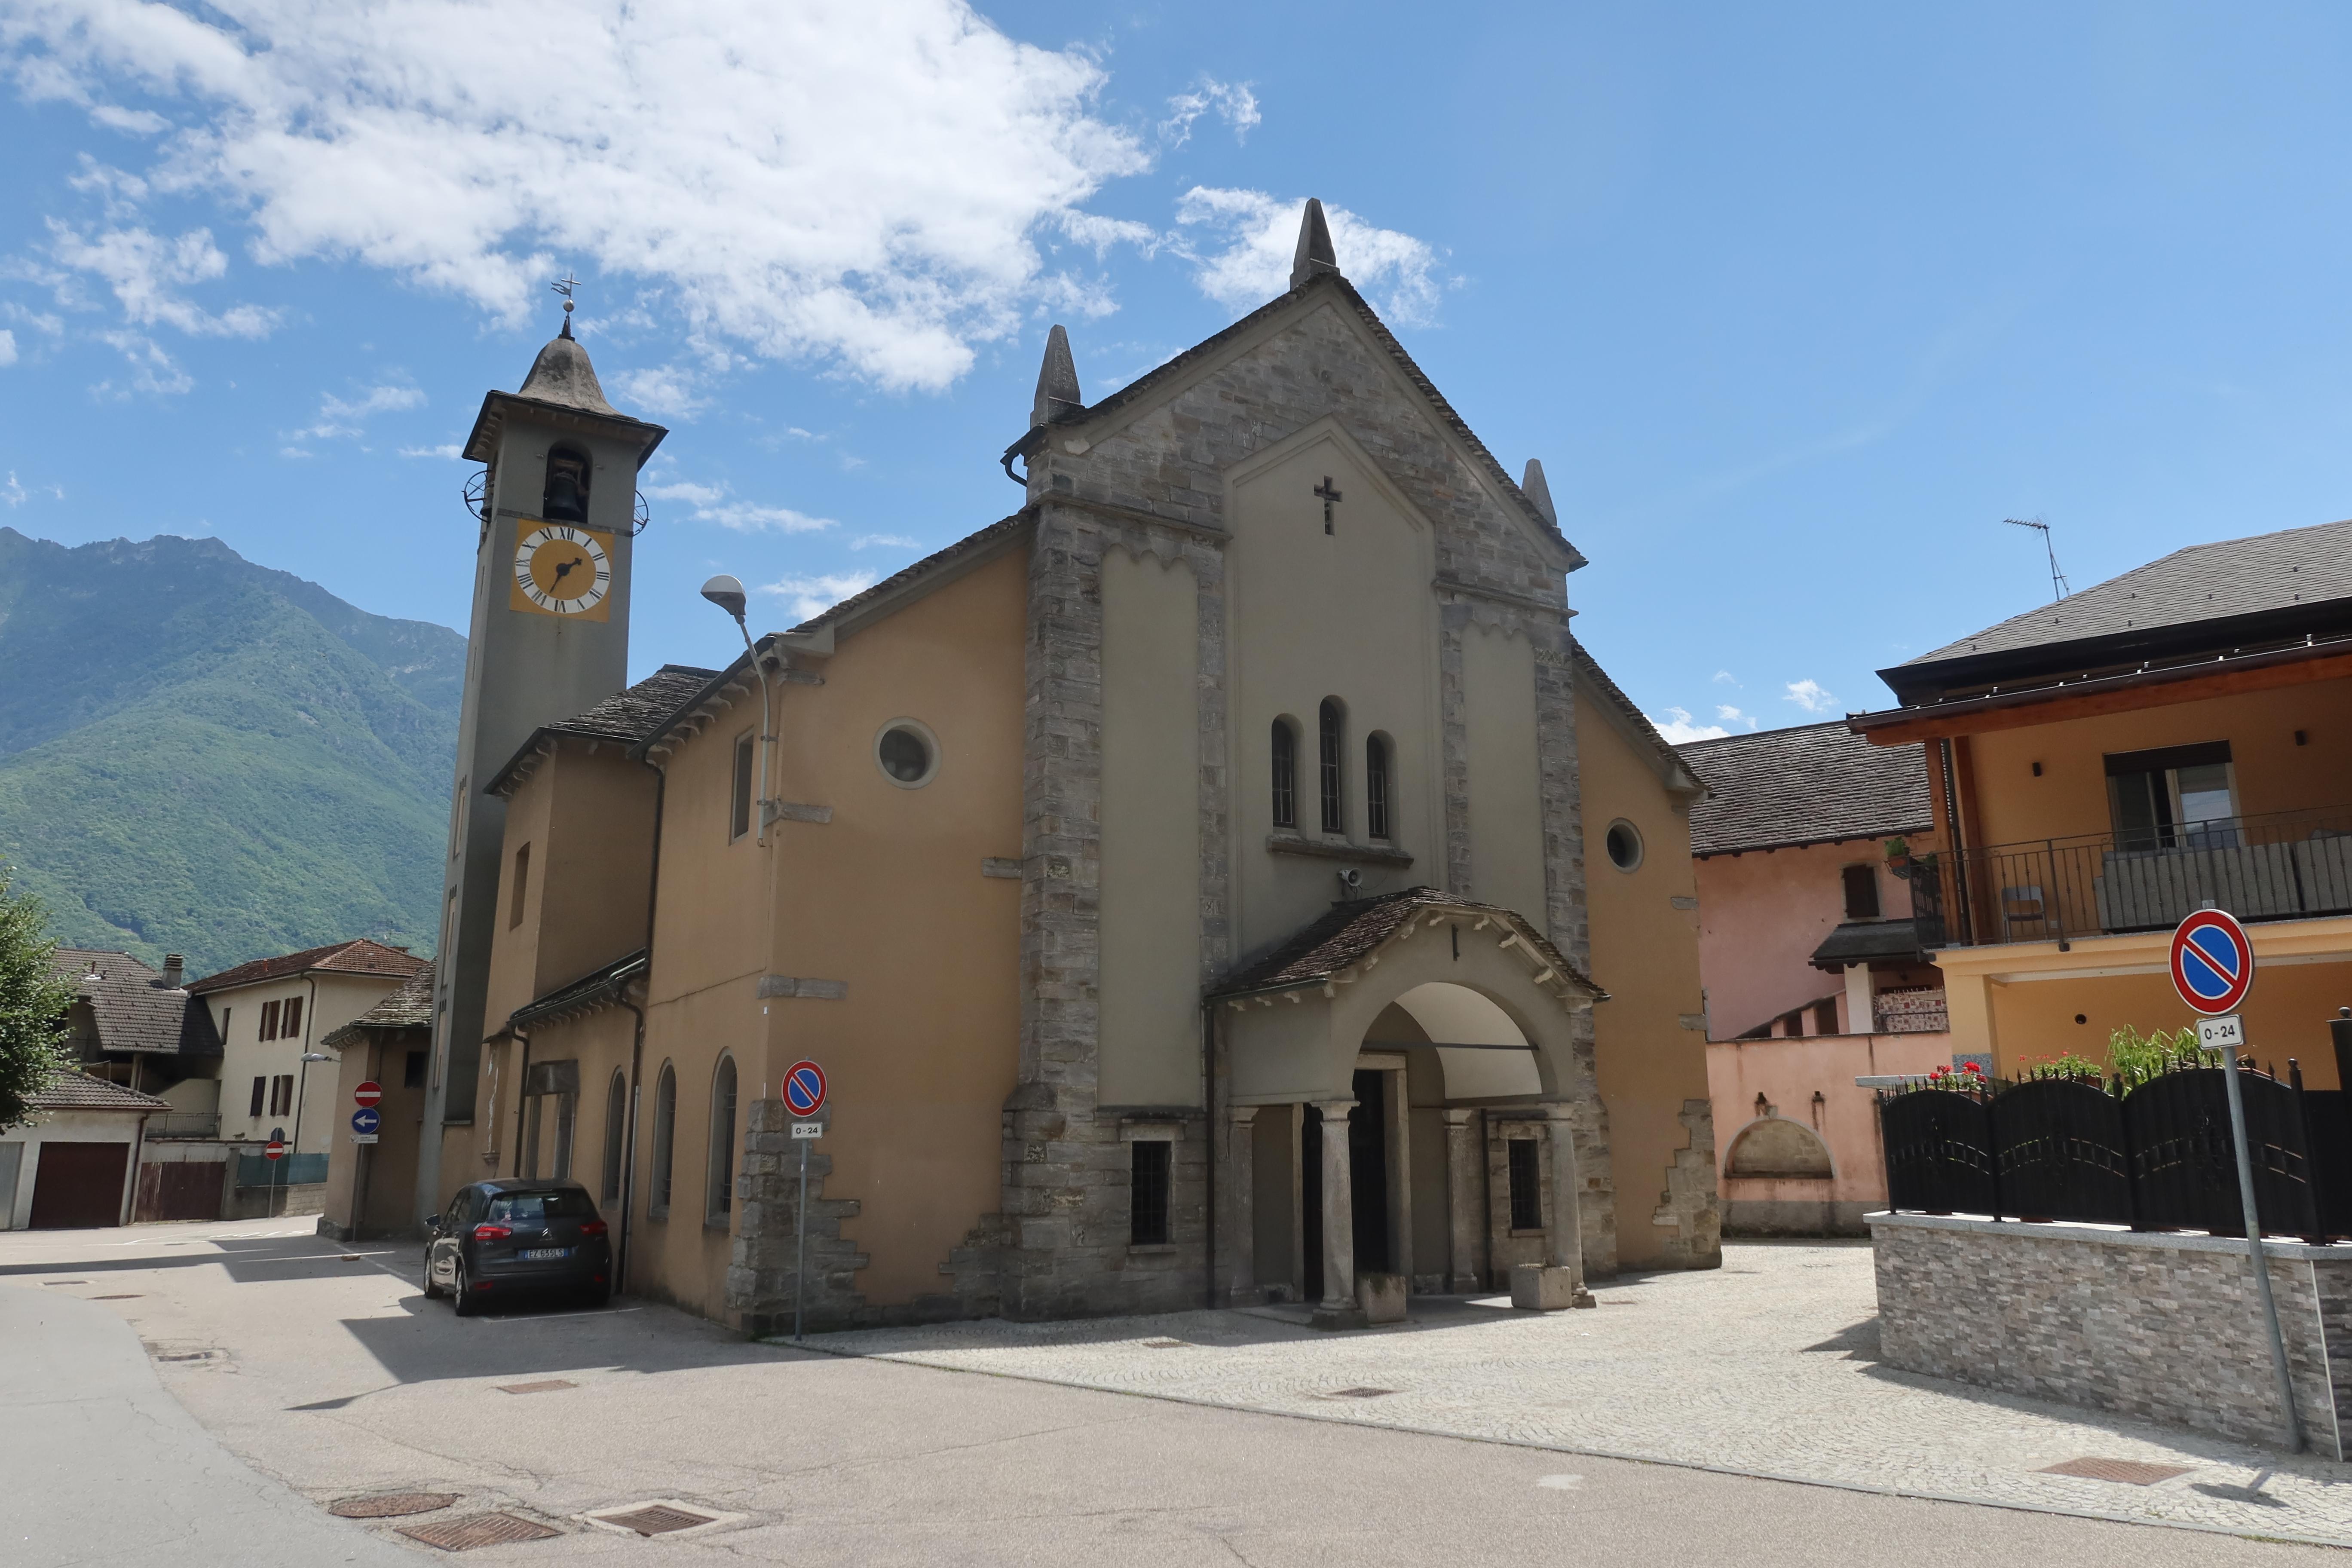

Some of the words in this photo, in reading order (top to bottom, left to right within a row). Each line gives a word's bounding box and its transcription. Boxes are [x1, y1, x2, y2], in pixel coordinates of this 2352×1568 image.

[539, 527, 553, 542] XI
[560, 527, 574, 541] XII
[522, 540, 537, 552] X
[584, 538, 592, 548] I
[515, 557, 531, 567] IX
[592, 552, 605, 561] II
[596, 571, 609, 581] III
[531, 589, 547, 606] VII
[554, 599, 566, 613] VI
[2205, 1028, 2212, 1040] 0
[2220, 1025, 2235, 1037] 24
